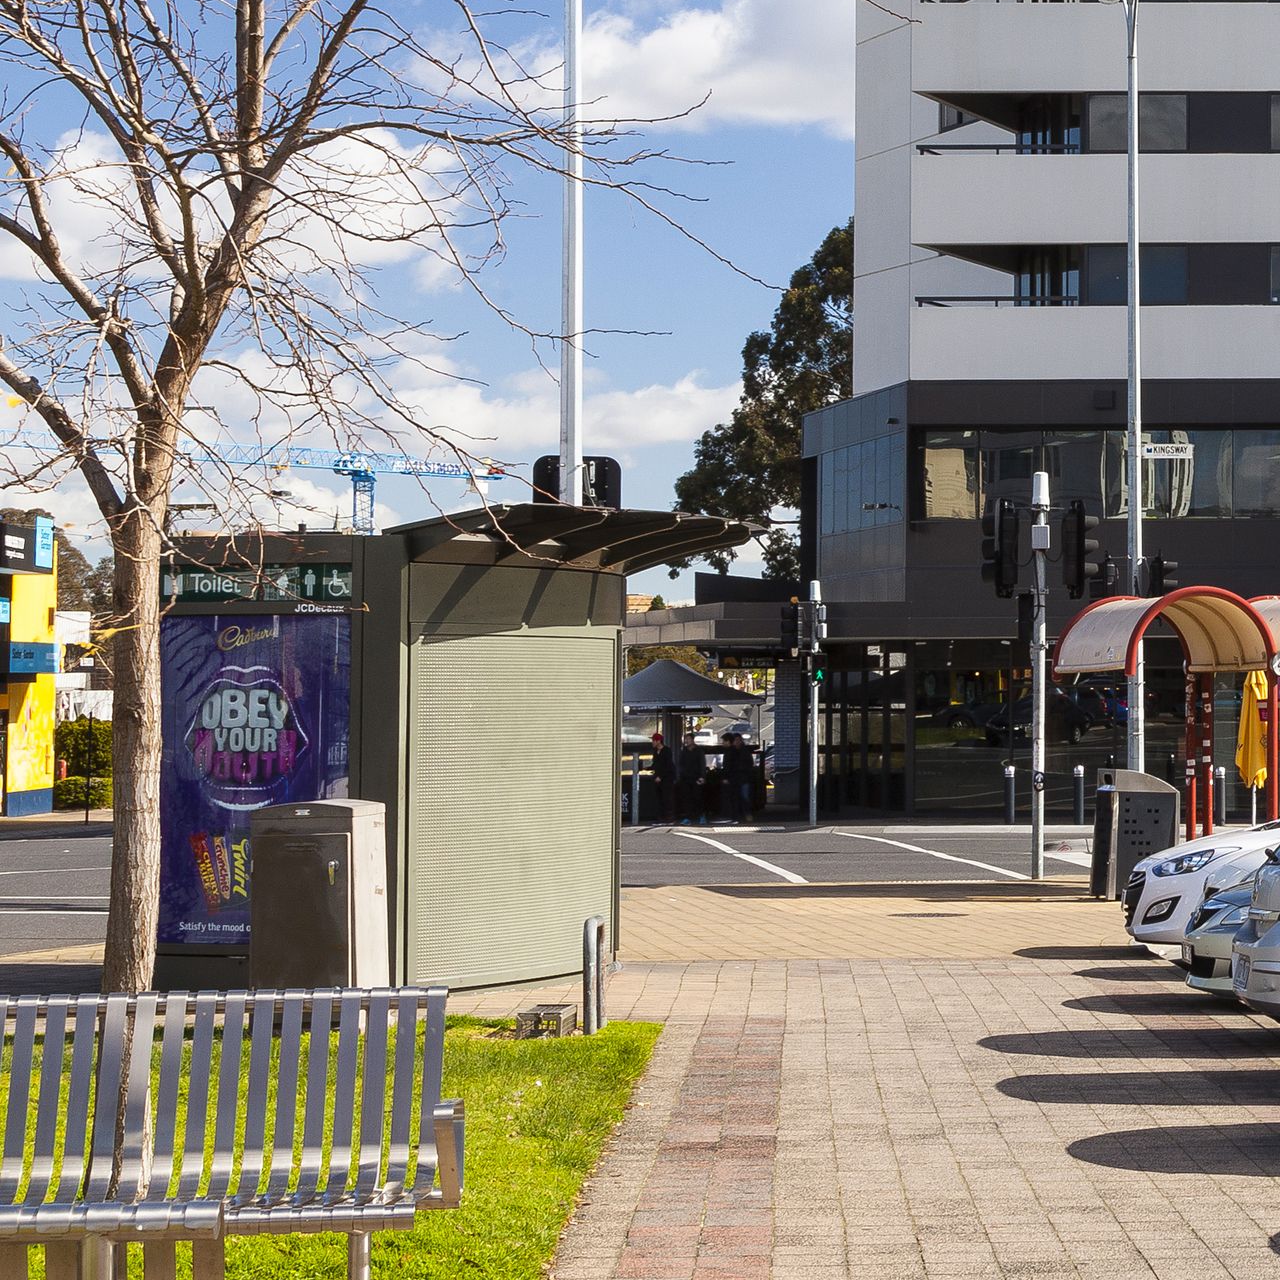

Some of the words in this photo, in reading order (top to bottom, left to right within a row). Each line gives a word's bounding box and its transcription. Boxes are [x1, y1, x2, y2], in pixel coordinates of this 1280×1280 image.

[1153, 446, 1188, 454] KINGSWAY
[190, 573, 241, 594] Toilet
[202, 689, 289, 730] OBEY
[214, 727, 278, 752] YOUR
[179, 921, 207, 933] Satisfy
[208, 922, 221, 931] the
[222, 923, 245, 932] mood
